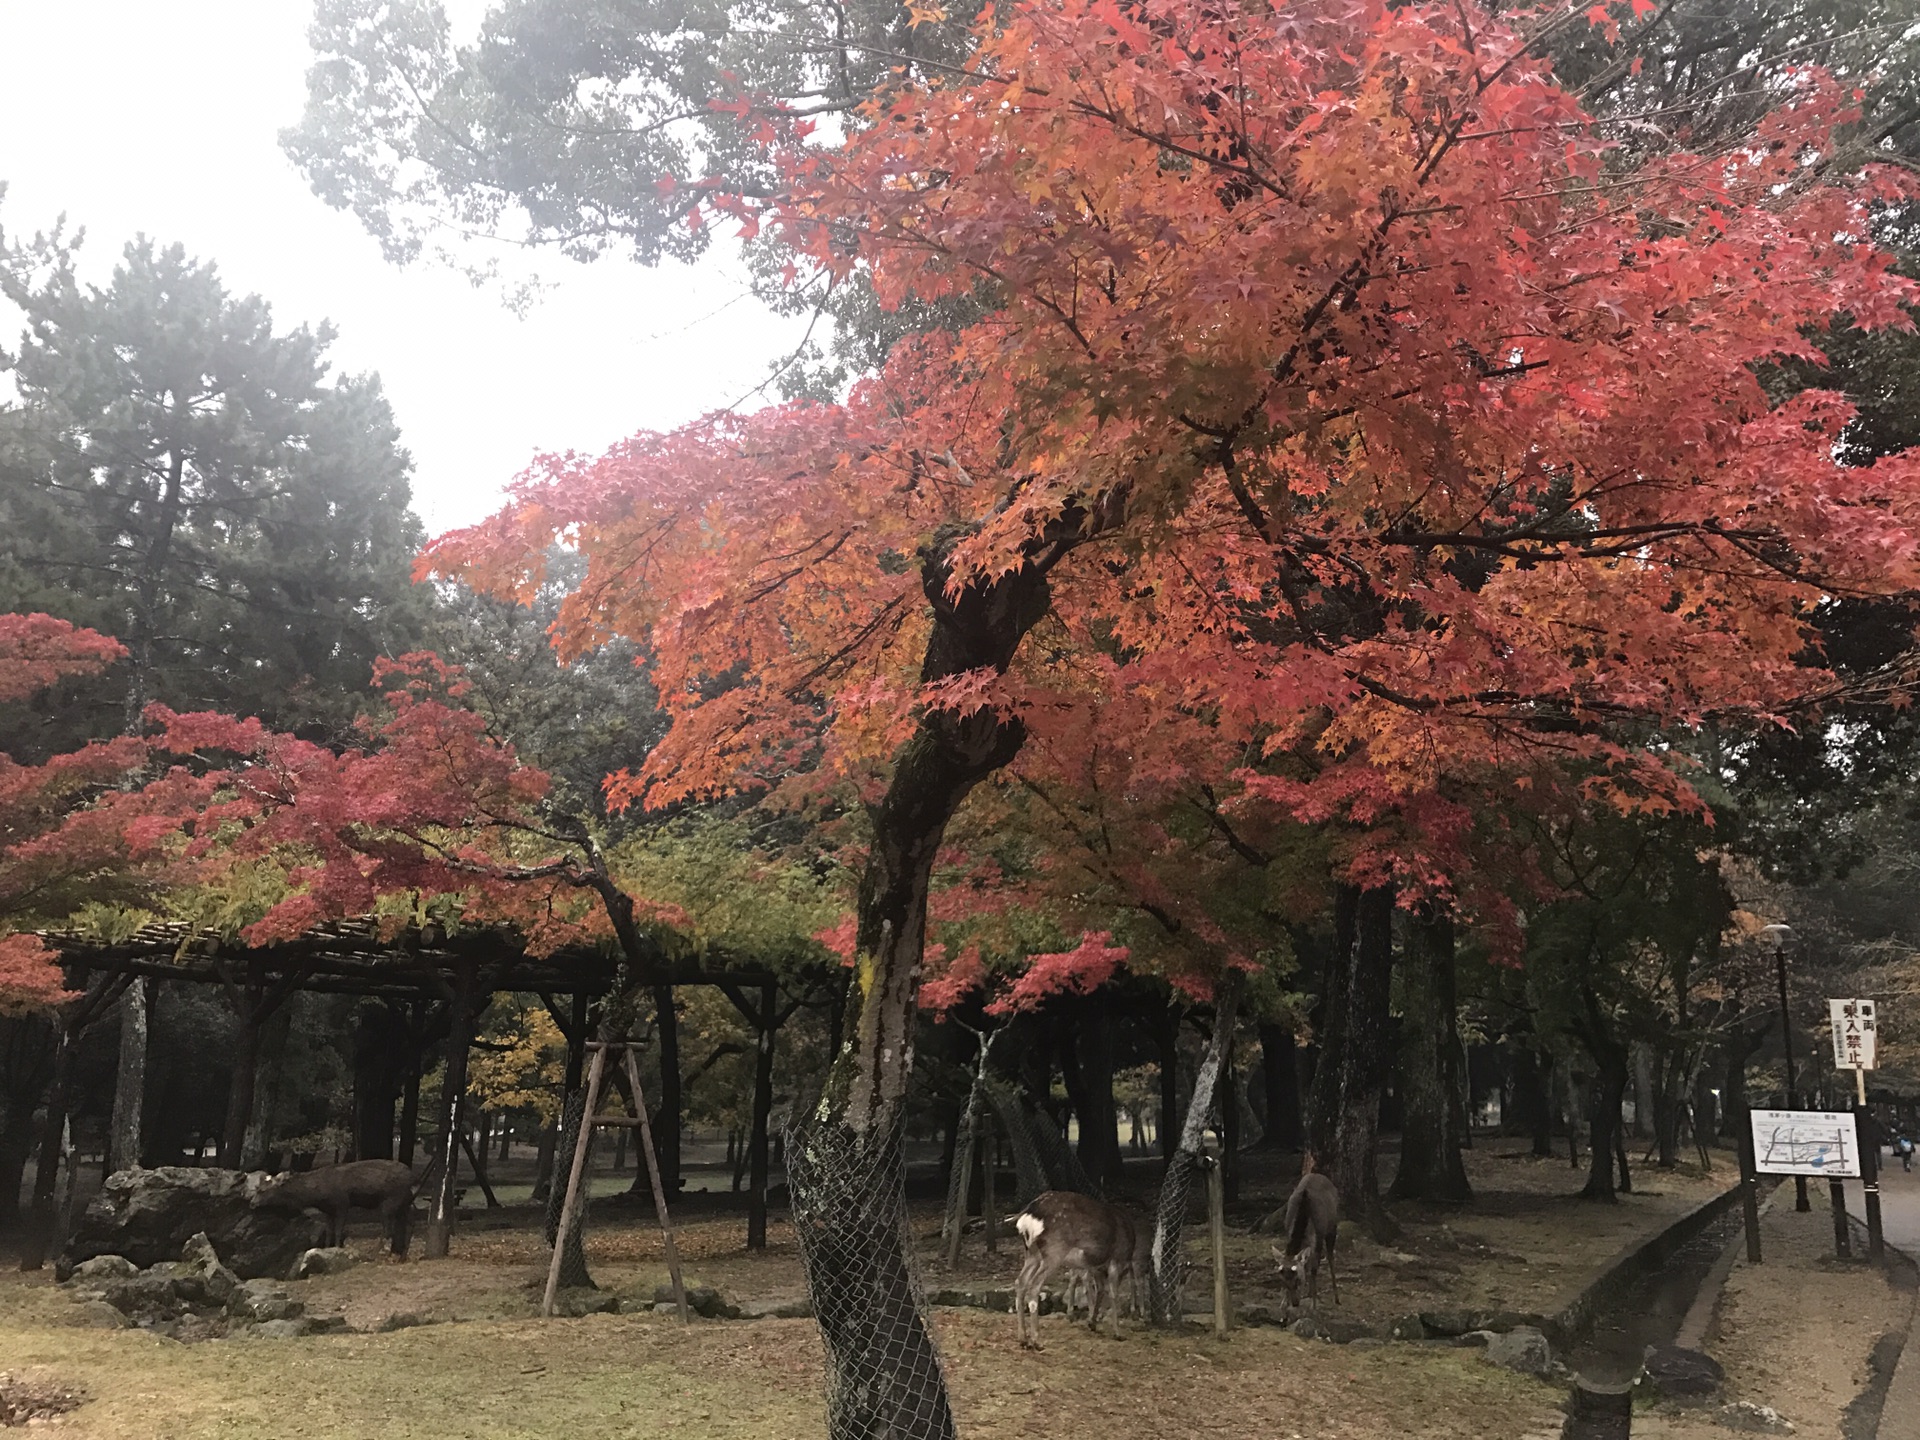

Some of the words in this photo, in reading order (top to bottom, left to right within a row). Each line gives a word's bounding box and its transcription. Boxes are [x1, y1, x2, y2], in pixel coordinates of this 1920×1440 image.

[1843, 1004, 1864, 1064] 乗入禁止
[1861, 1005, 1875, 1032] 車両
